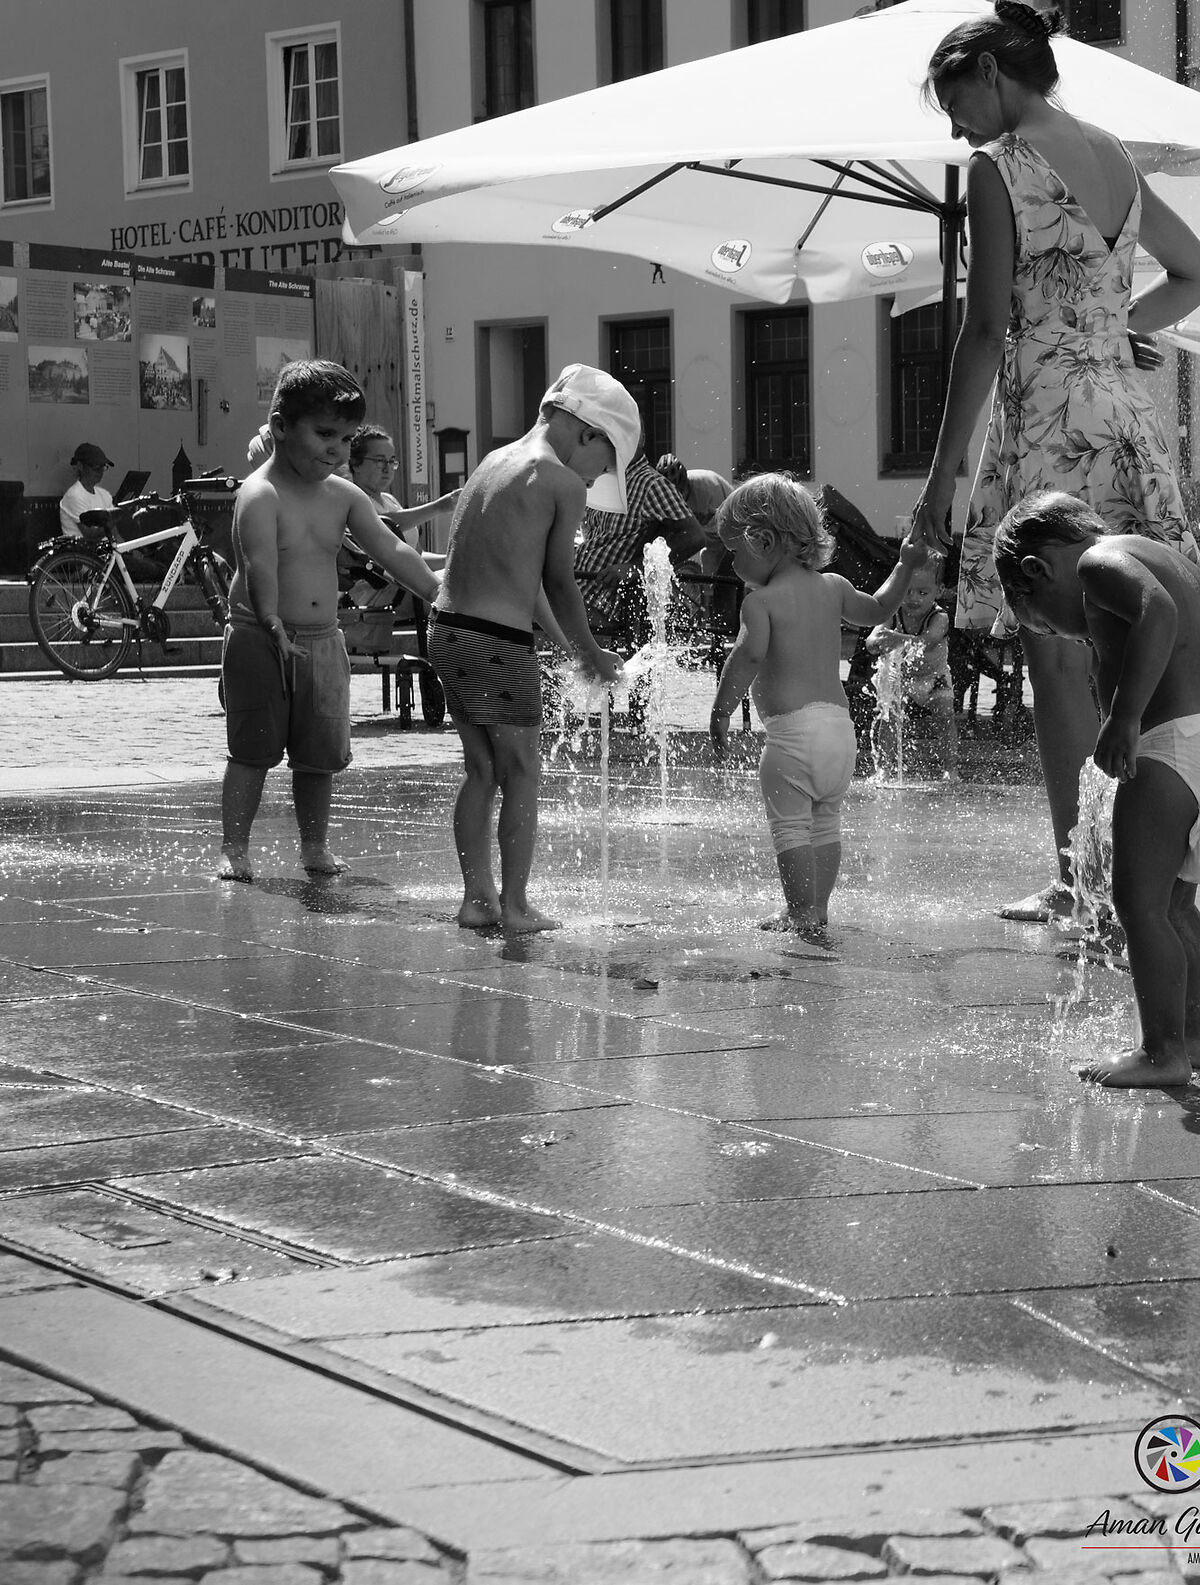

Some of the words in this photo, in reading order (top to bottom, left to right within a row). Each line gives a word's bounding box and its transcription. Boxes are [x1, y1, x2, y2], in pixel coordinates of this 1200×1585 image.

[110, 221, 172, 251] HOTEL
[179, 206, 228, 244] CAFÉ
[235, 201, 344, 238] KONDITOR
[408, 298, 423, 474] www.denkmalschutz.de
